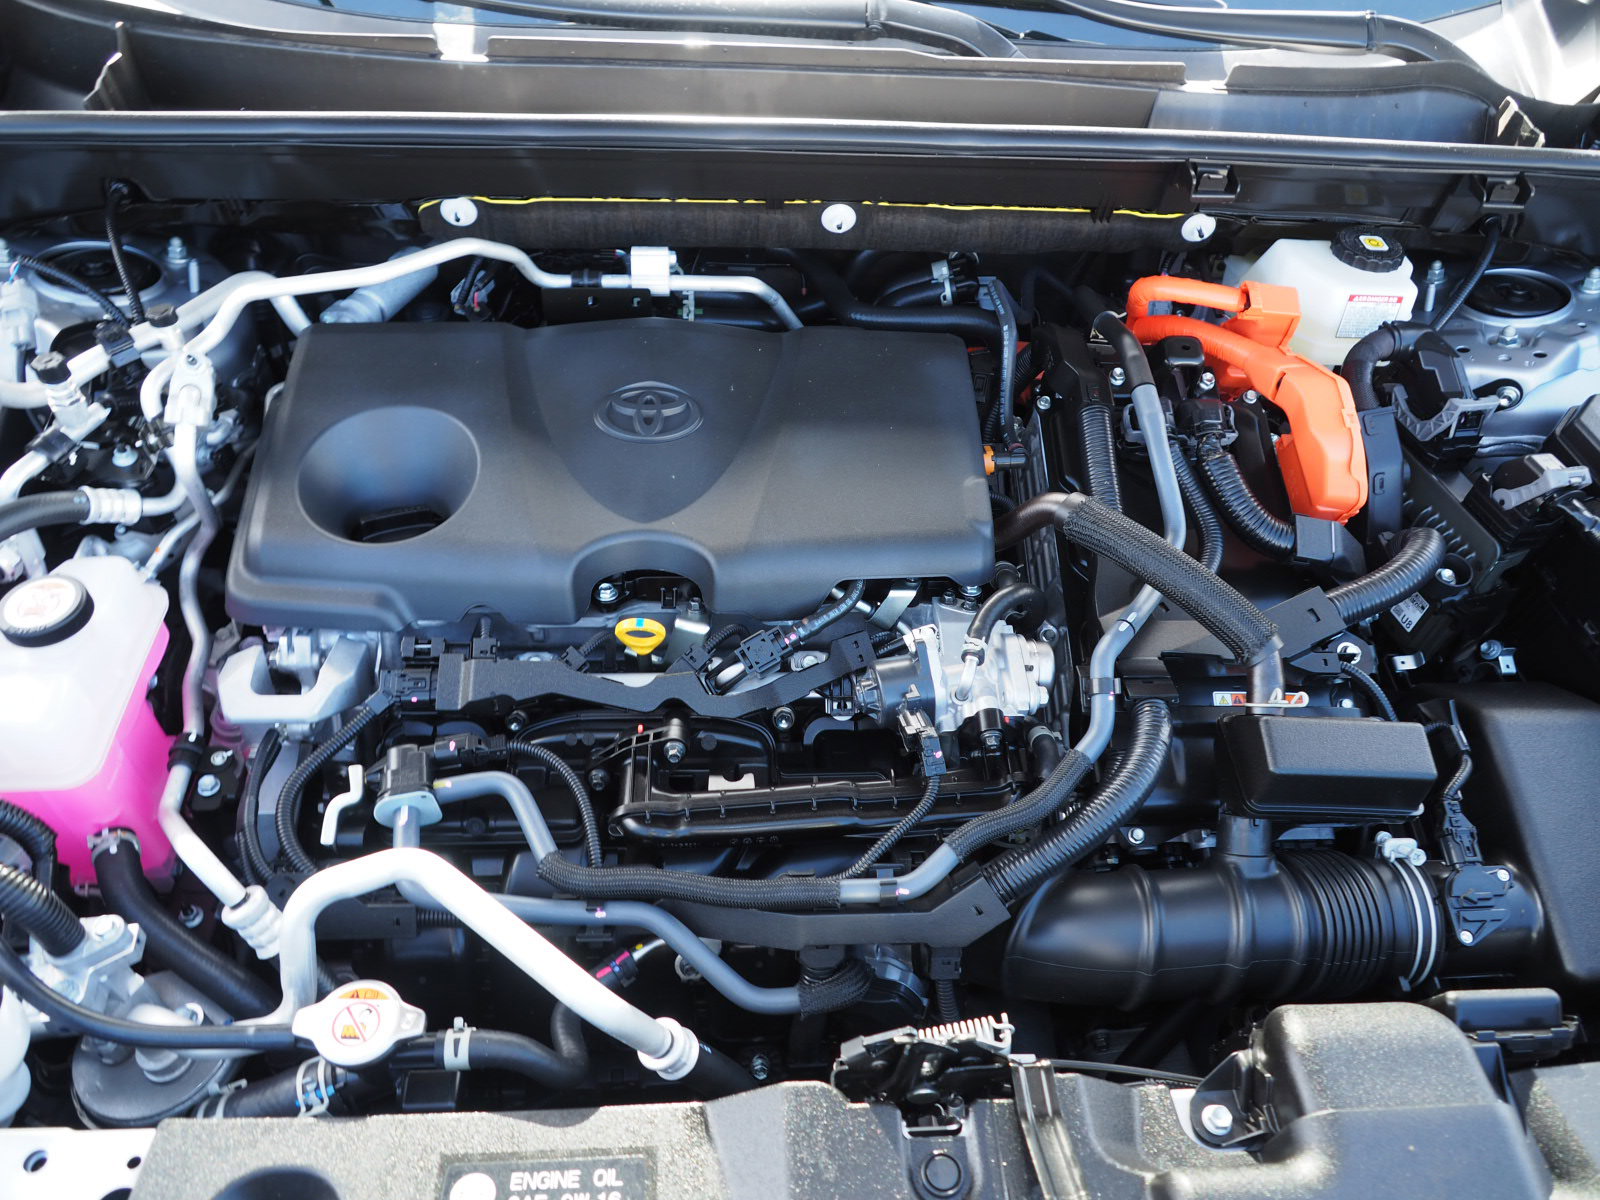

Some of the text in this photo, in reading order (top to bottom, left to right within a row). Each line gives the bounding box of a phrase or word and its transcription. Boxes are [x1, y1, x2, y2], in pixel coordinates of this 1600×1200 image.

[1401, 614, 1412, 628] U8
[509, 1168, 624, 1191] ENGINE OIL
